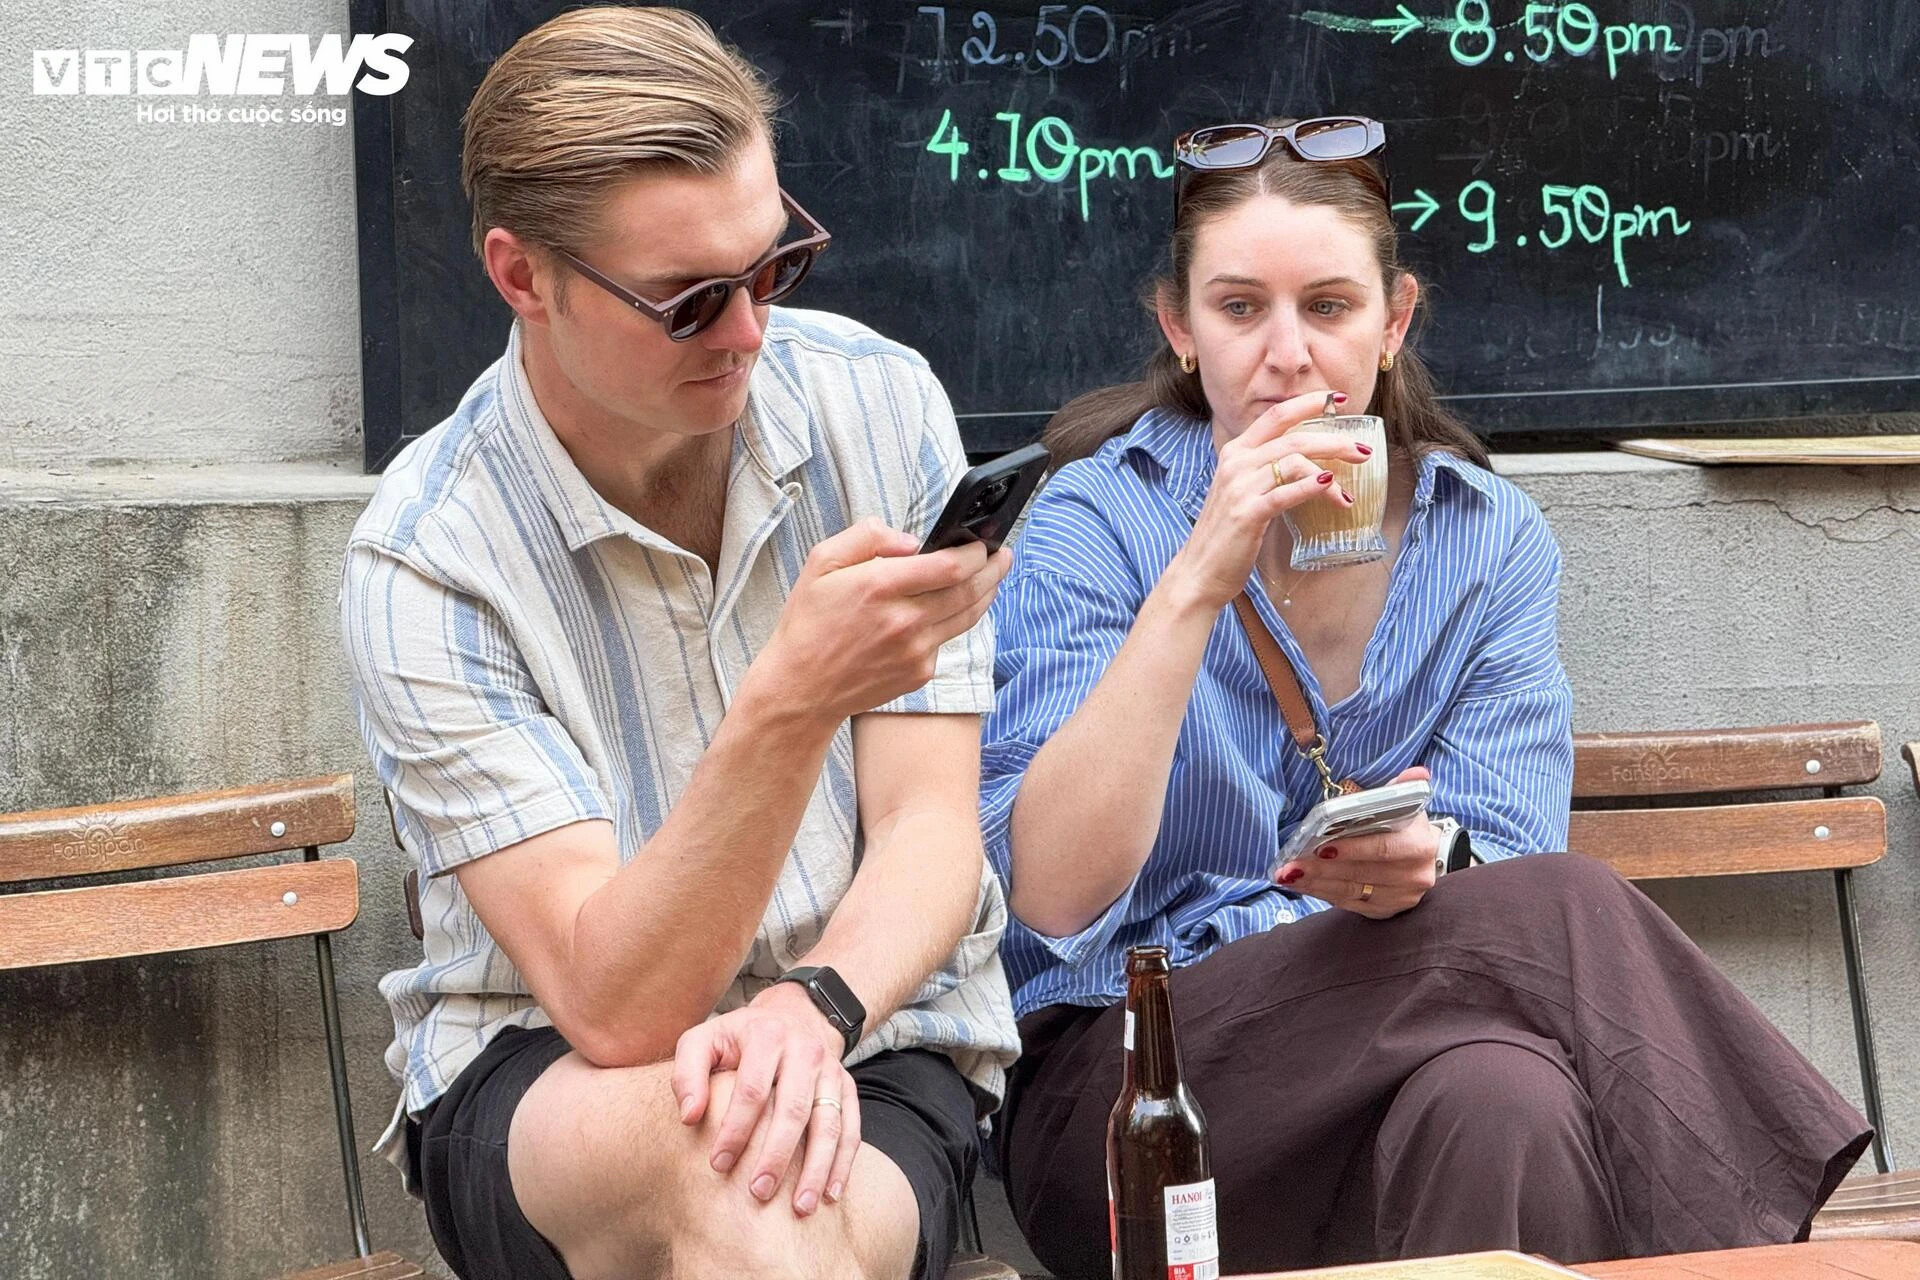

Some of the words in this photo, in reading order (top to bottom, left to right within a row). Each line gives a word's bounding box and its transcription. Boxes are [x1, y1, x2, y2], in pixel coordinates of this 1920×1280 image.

[1449, 0, 1683, 80] 8.50pm
[926, 108, 1175, 222] 4.10pm
[1457, 179, 1692, 288] 9.50pm
[1172, 1191, 1203, 1205] HANOI
